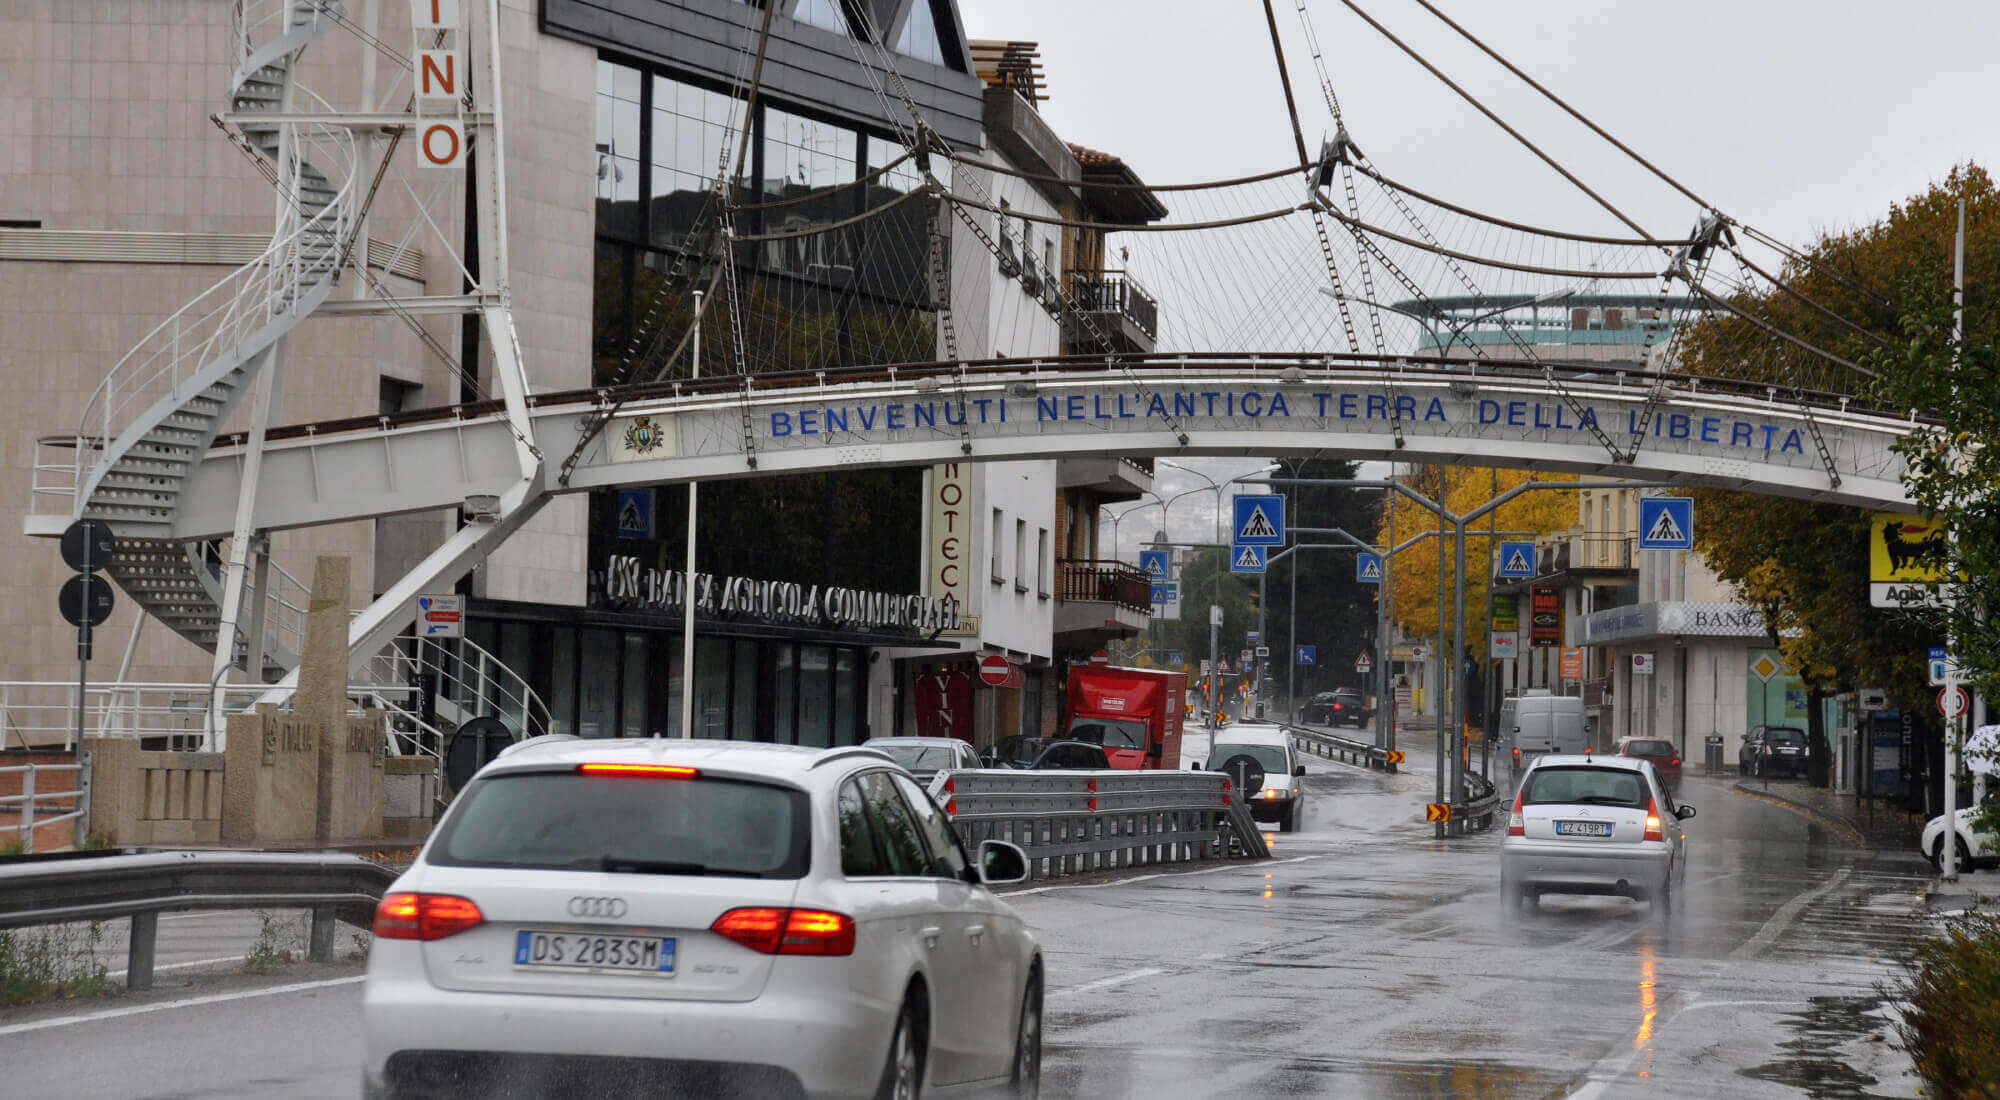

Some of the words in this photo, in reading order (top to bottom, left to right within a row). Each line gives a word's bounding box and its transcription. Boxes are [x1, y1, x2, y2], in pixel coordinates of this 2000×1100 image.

[770, 398, 1006, 437] BENVENUTI
[1037, 391, 1290, 421] NELL'ANTICA
[1312, 392, 1447, 422] TERRA
[1478, 398, 1600, 432] DELLA
[720, 576, 819, 619] AGRICOLA
[824, 586, 961, 631] COMMERCIALE
[1695, 610, 1764, 628] BANC
[533, 935, 563, 962] DS
[574, 937, 658, 967] 283SM
